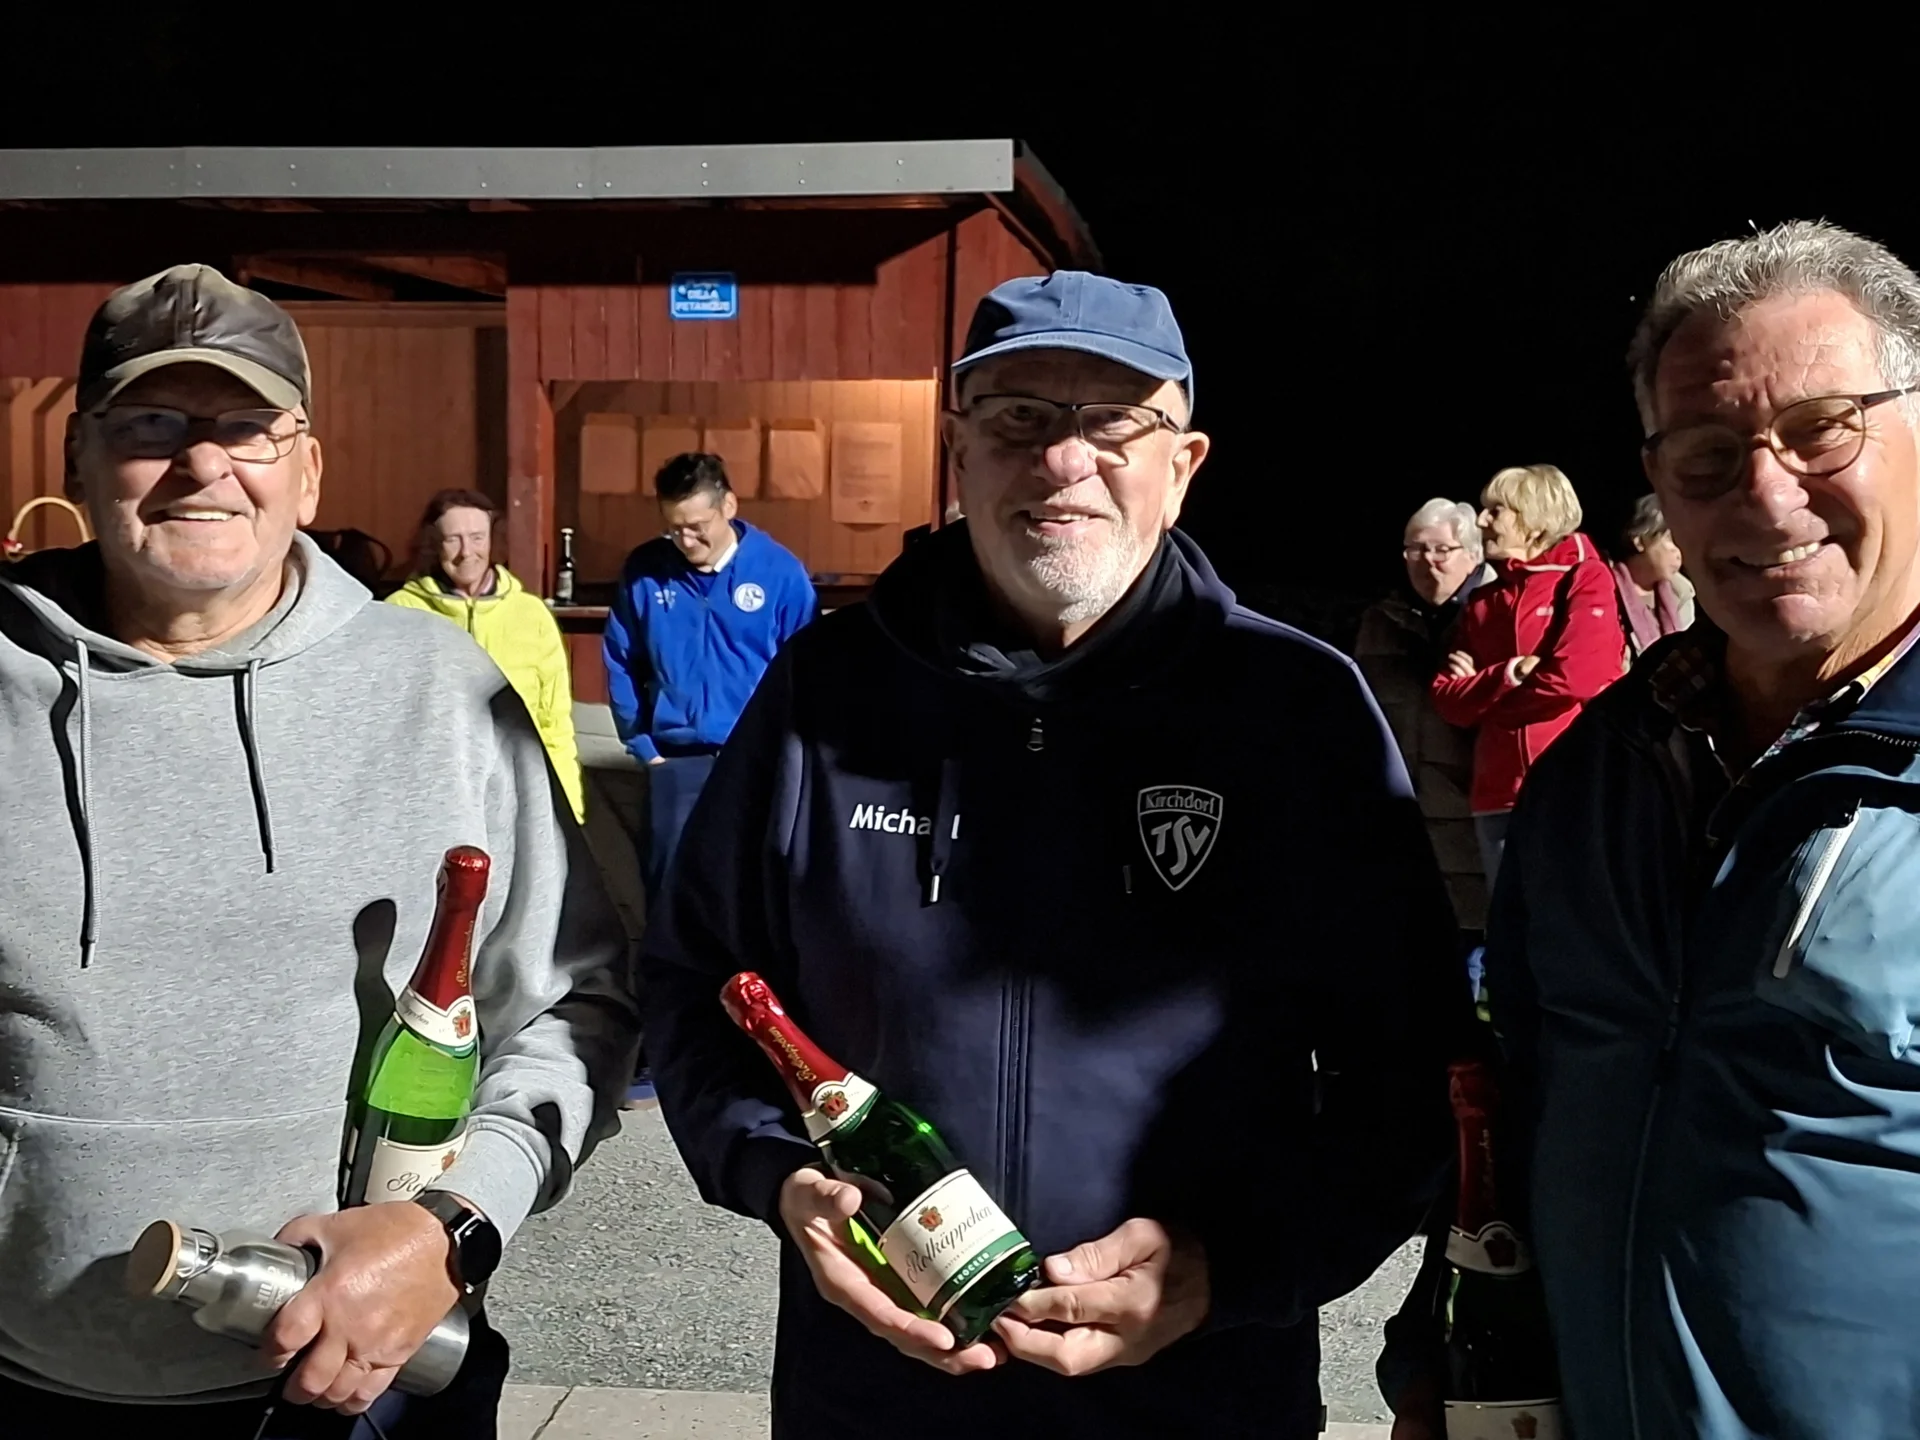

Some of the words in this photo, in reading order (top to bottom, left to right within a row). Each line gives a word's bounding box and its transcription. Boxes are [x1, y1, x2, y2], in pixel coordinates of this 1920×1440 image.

[849, 803, 960, 839] Michal
[1145, 790, 1215, 814] Kirchdorf
[1151, 815, 1211, 876] TSV
[904, 1203, 994, 1284] Rotkäppchen
